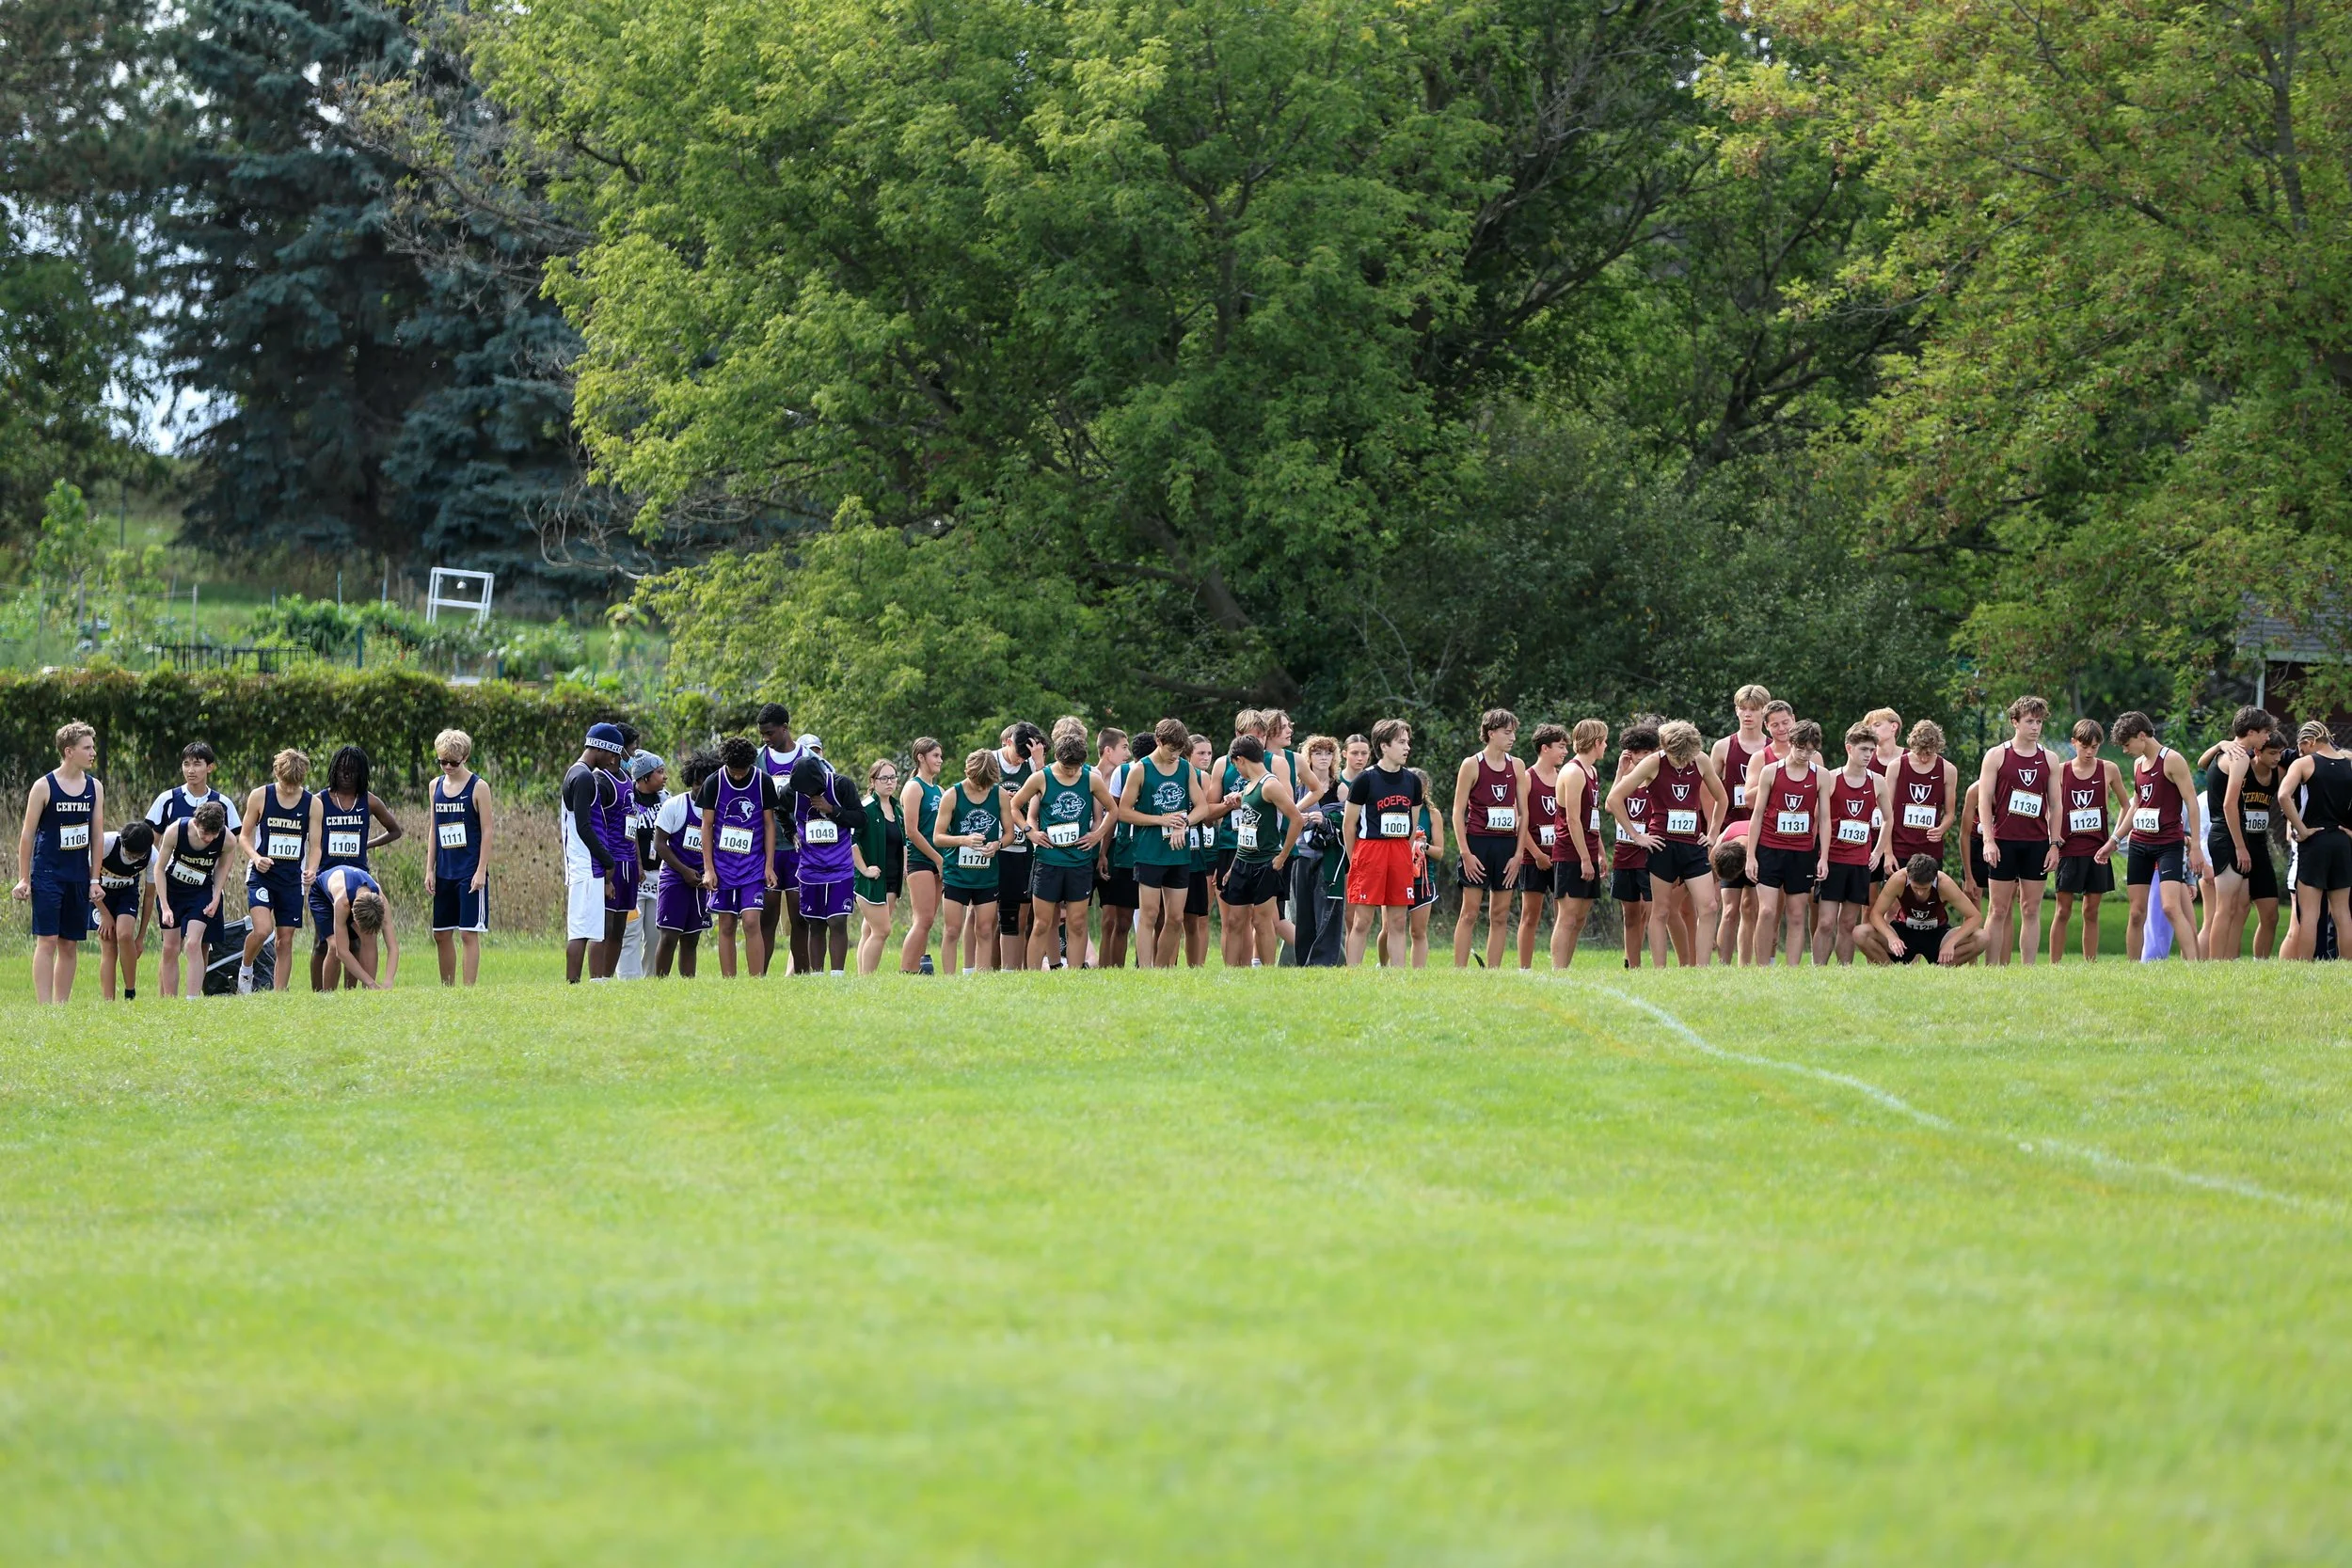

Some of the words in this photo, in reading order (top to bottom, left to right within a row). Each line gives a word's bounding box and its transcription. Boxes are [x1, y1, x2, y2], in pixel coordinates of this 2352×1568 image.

[56, 802, 90, 812] CENTRAL
[436, 802, 465, 813] CENTRAL
[2012, 800, 2038, 814] 1139
[267, 817, 301, 829] CENTRAL
[326, 816, 363, 826] CENTRAL
[1491, 817, 1512, 827] 1132
[1671, 820, 1693, 830] 1127
[1908, 814, 1932, 826] 1140
[2074, 817, 2098, 829] 1122
[2135, 818, 2155, 829] 1129
[2248, 819, 2266, 830] 1068
[1385, 822, 1406, 832] 1001
[1781, 821, 1804, 832] 1131
[442, 832, 462, 844] 1111
[809, 829, 834, 838] 1048
[1052, 832, 1076, 843] 1175
[1842, 829, 1866, 841] 1138
[65, 834, 87, 847] 1106
[723, 836, 749, 849] 1049
[272, 844, 297, 855] 1107
[332, 842, 357, 852] 1109
[962, 855, 987, 864] 1170
[1406, 887, 1414, 899] R
